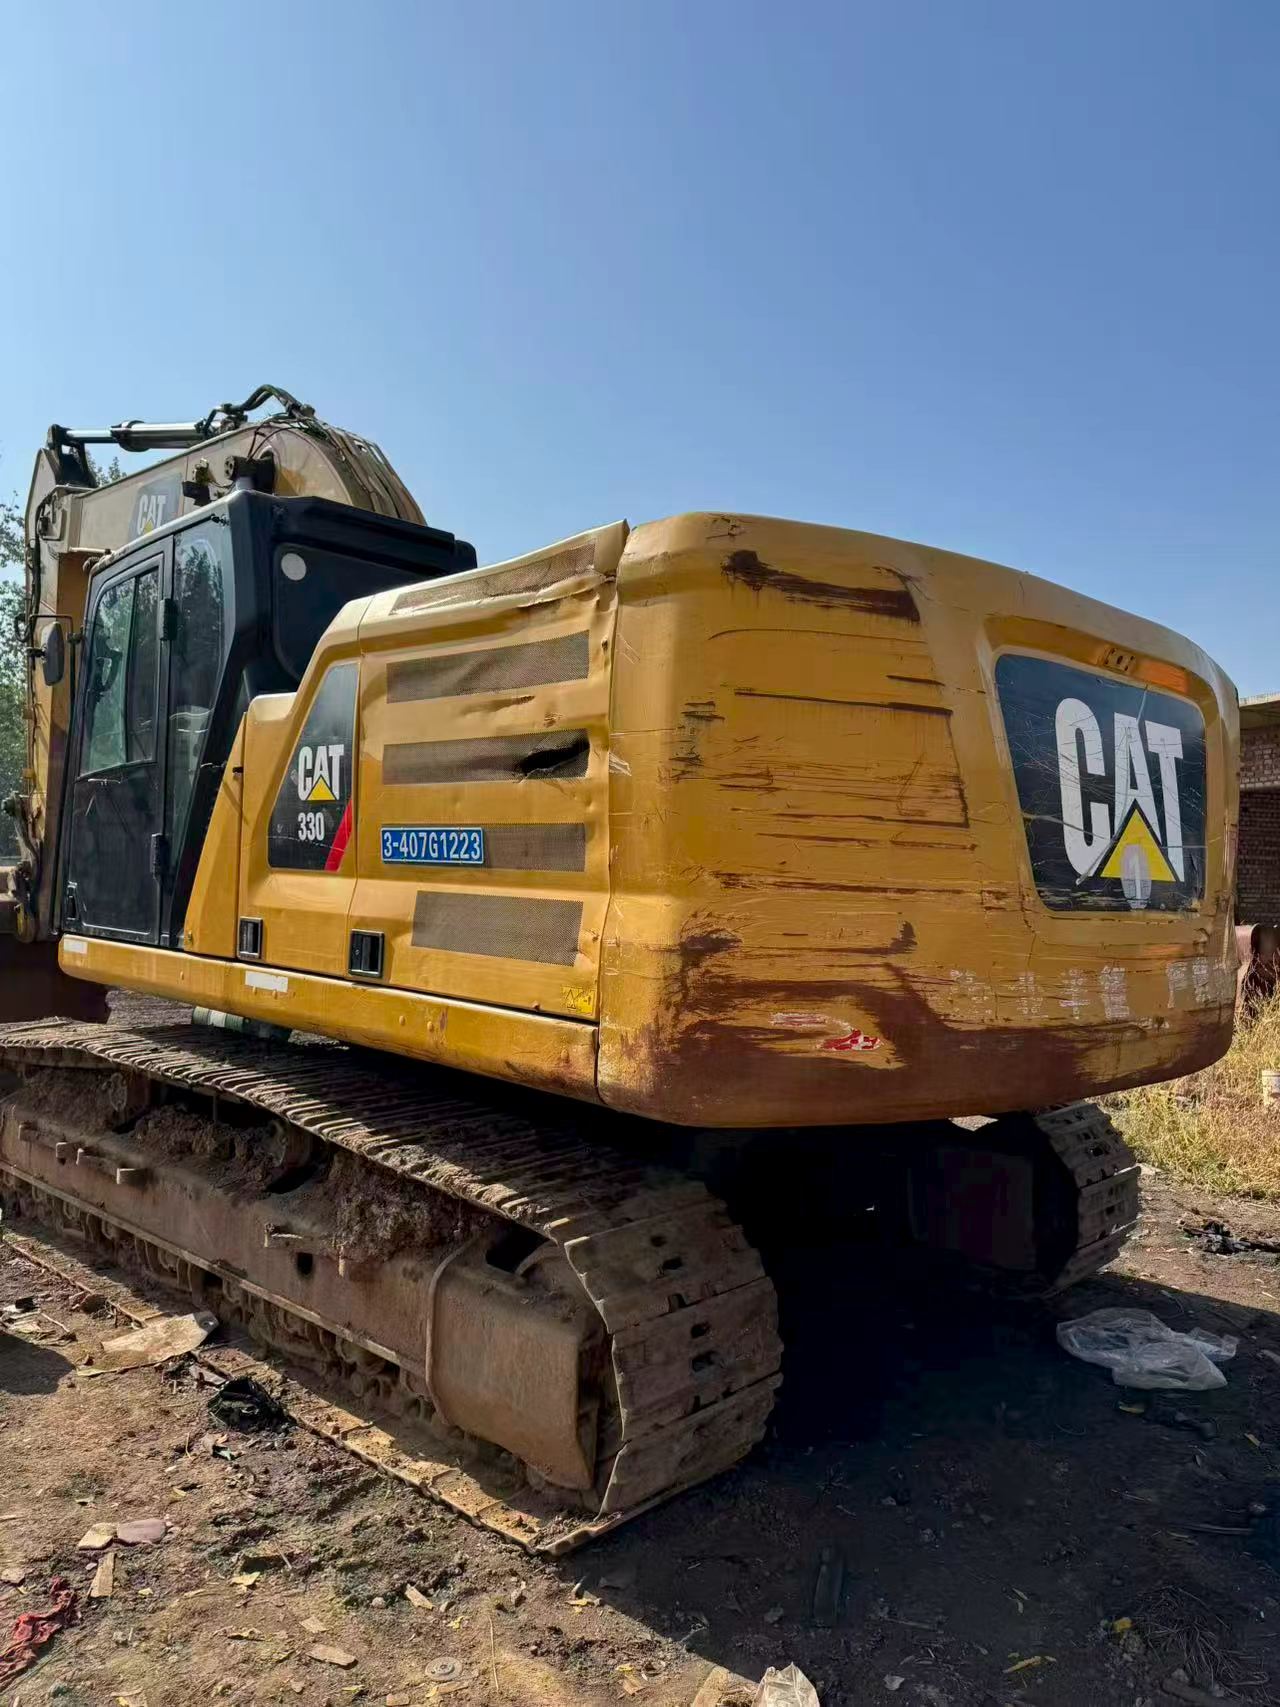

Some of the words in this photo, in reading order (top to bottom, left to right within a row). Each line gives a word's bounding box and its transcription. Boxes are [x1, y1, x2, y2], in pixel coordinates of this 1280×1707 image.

[137, 494, 168, 536] CAT
[297, 744, 345, 801] CAT
[1055, 697, 1186, 883] CAT
[297, 811, 325, 841] 330
[383, 831, 480, 860] 3-407G1223
